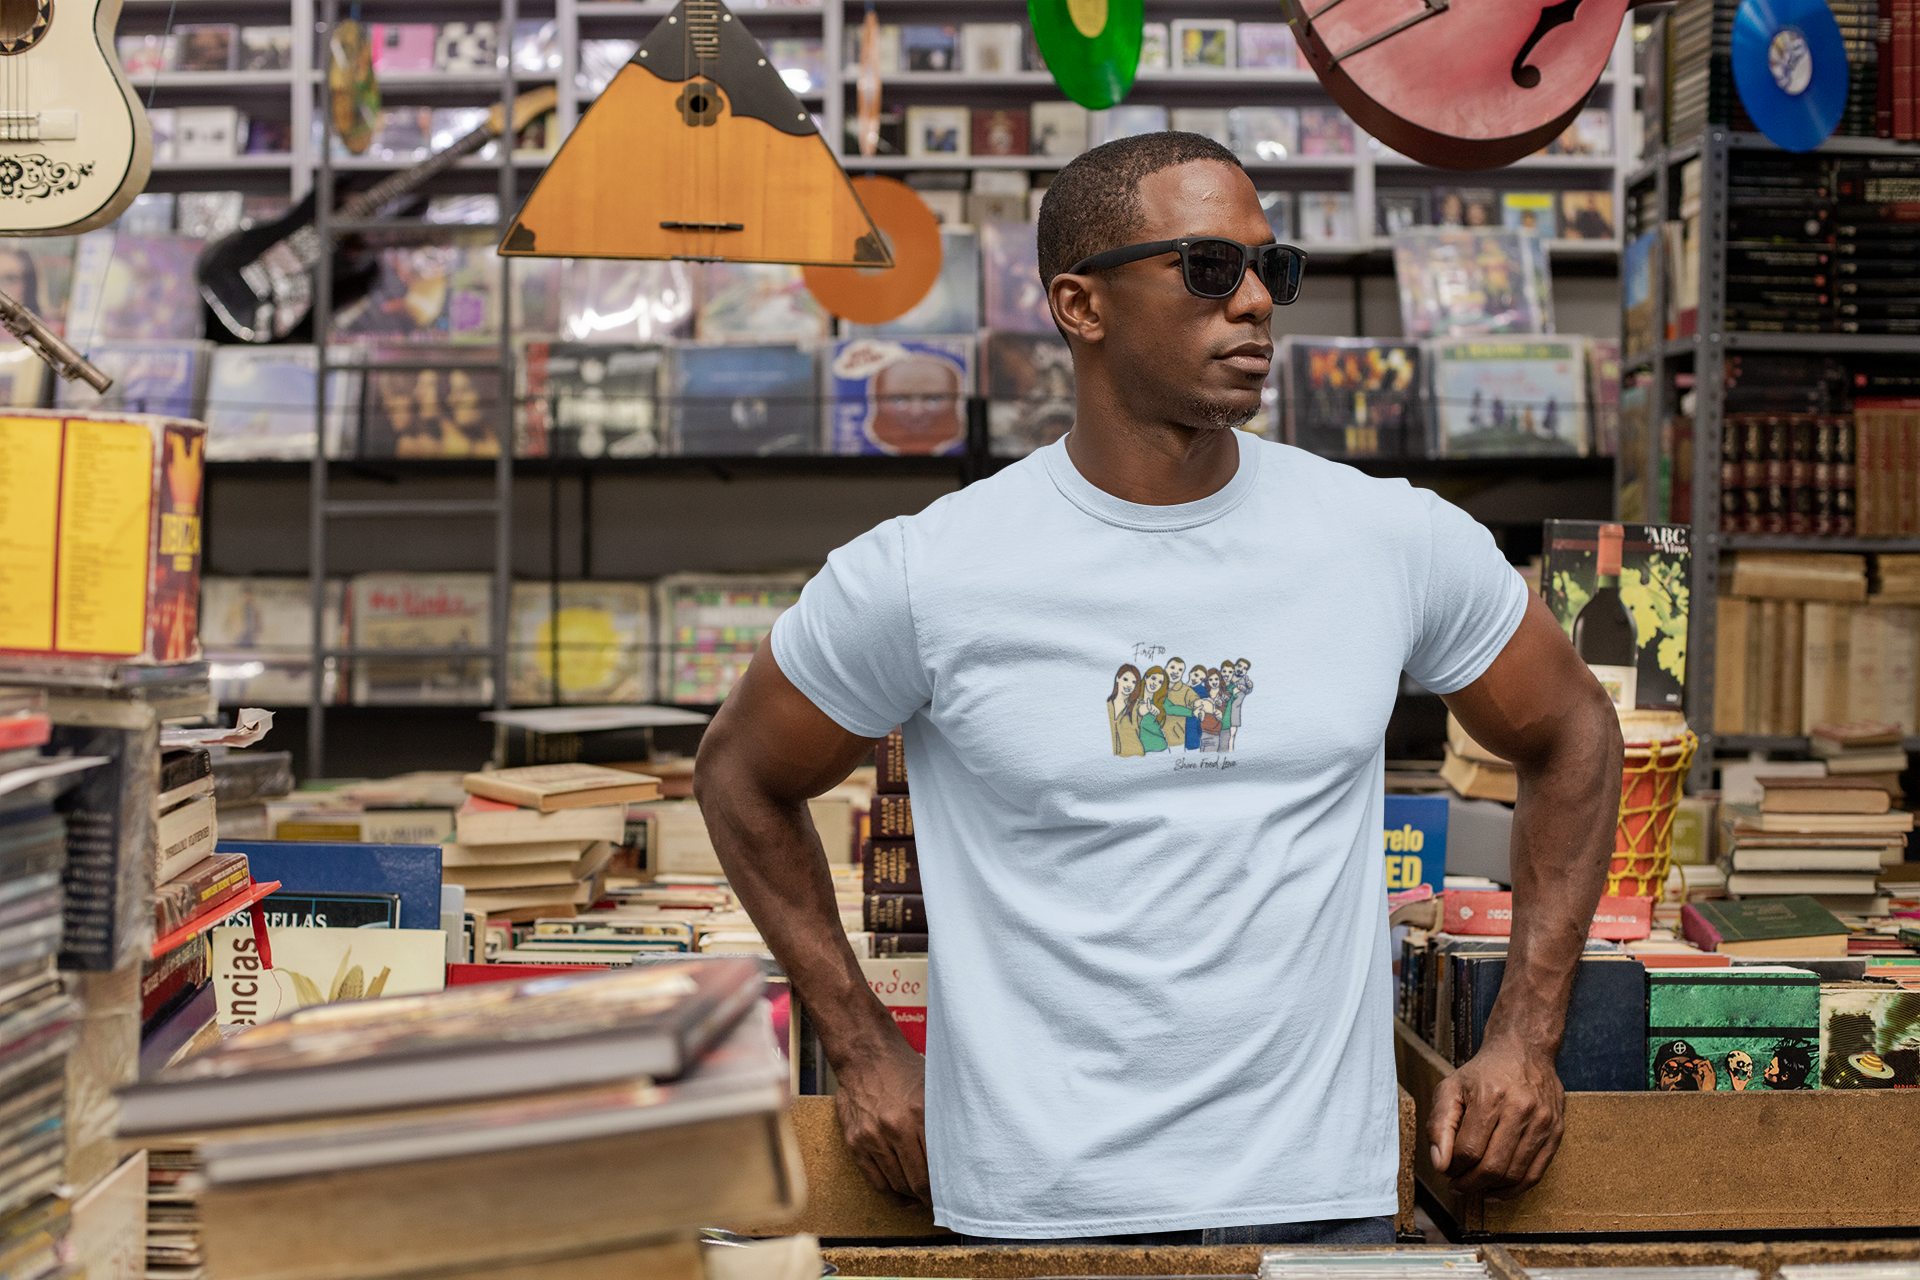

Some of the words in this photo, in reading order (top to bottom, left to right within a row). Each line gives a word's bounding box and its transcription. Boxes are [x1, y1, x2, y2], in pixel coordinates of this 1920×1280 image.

[1309, 348, 1414, 390] KISS
[881, 797, 889, 834] AMADO
[873, 847, 882, 884] AMADO
[224, 910, 327, 928] ESRELLAS
[1487, 909, 1512, 920] INSO
[1617, 915, 1637, 924] KING
